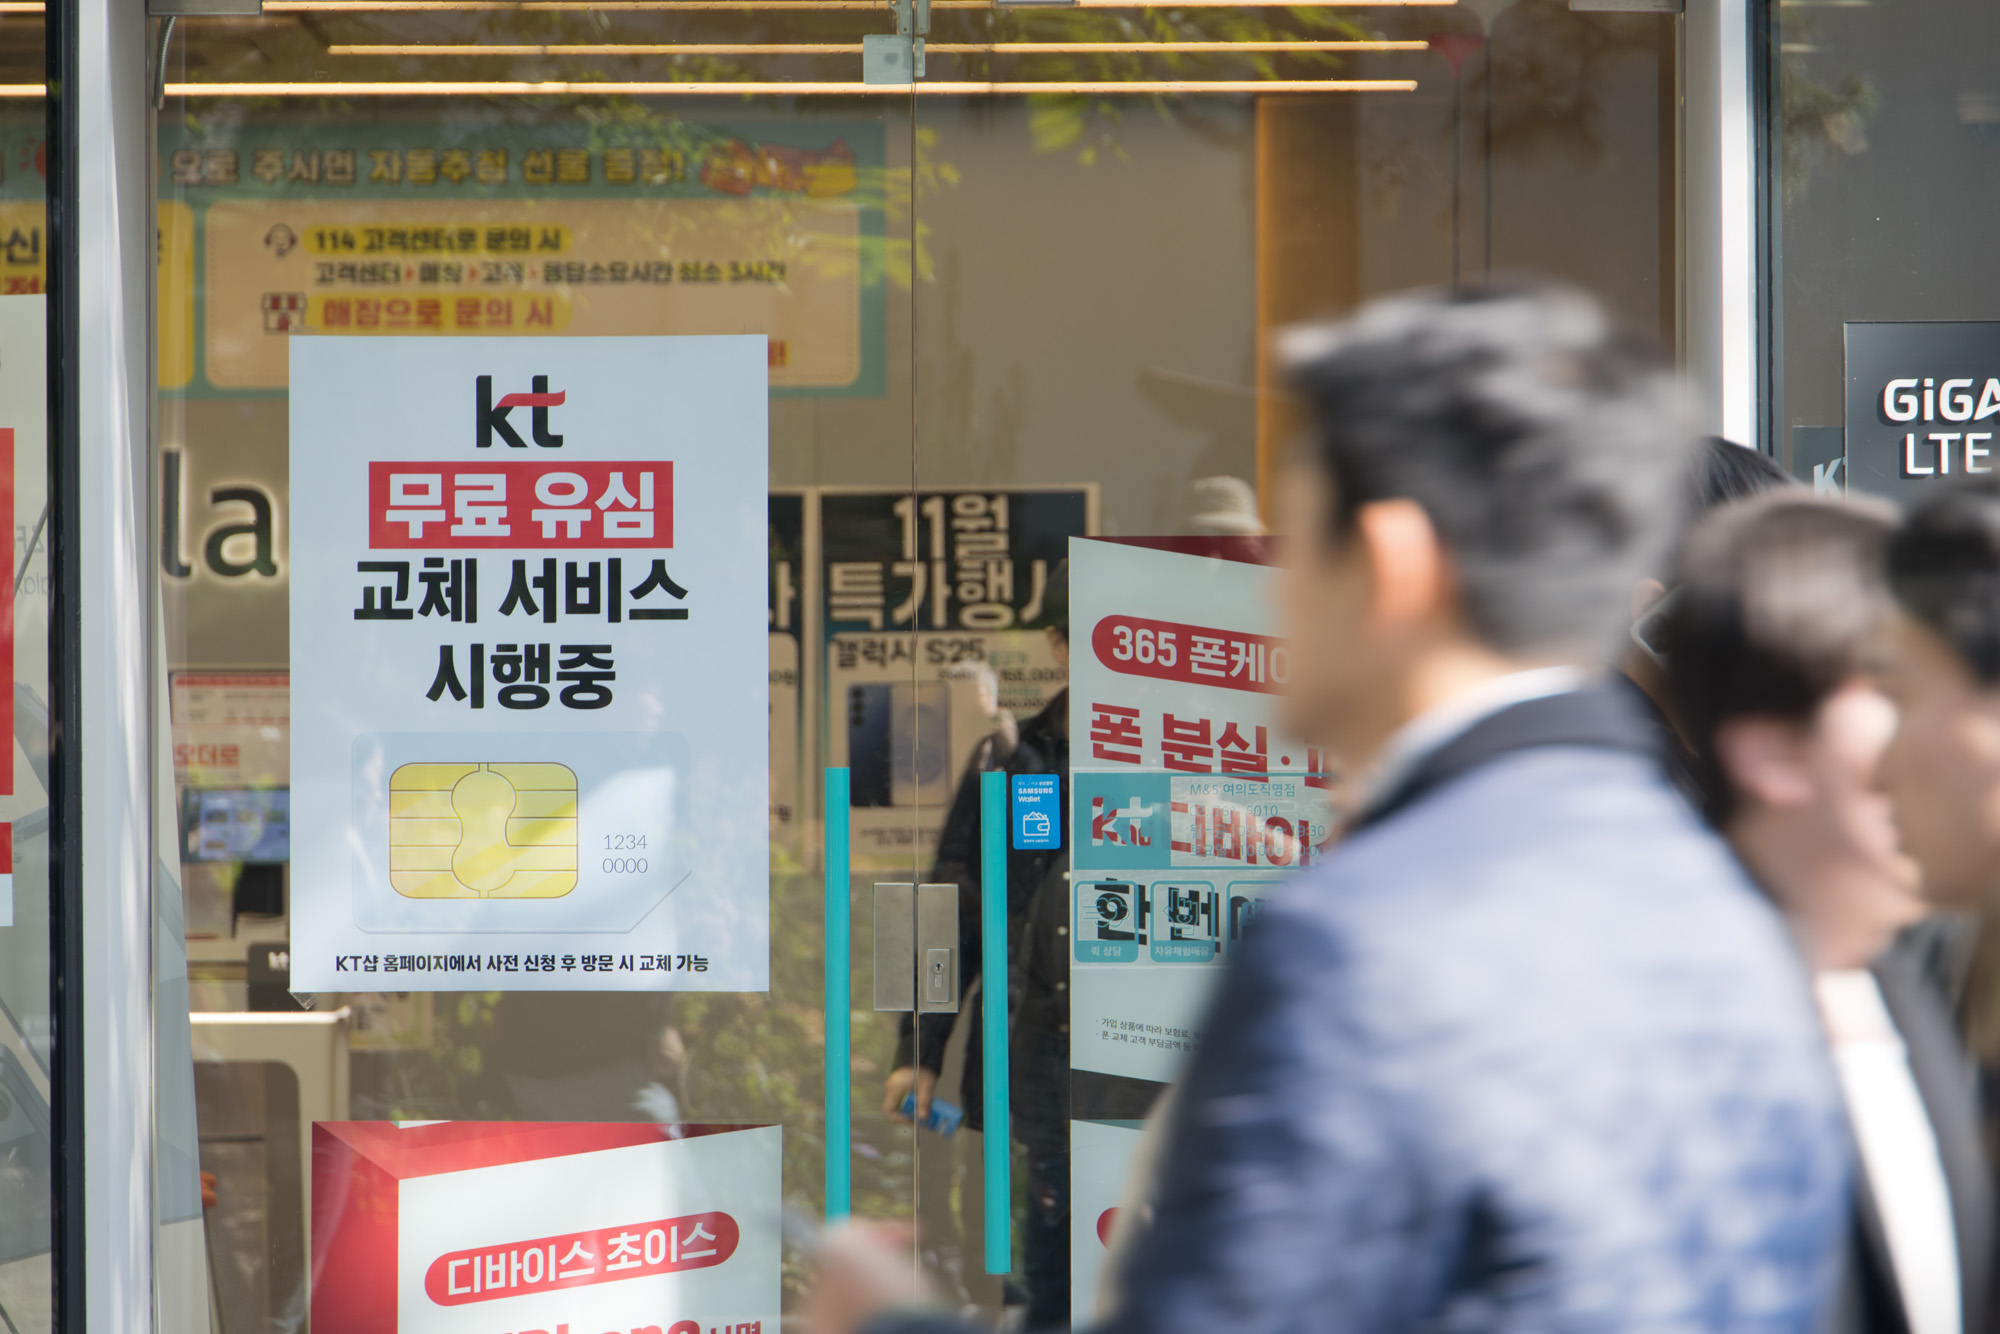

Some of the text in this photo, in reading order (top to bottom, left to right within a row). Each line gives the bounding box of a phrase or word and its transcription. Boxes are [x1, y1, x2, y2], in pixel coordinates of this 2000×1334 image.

[253, 149, 357, 184] 주시면
[315, 228, 356, 251] 114
[538, 228, 561, 252] 시
[324, 297, 553, 328] 매장으로 문의 시
[476, 375, 565, 448] kt
[1905, 432, 1992, 475] LTE
[385, 471, 655, 539] 무료 유심
[892, 494, 1009, 560] 11월
[354, 557, 689, 623] 교체 서비스
[833, 637, 987, 669] 갤럭시 S25
[1112, 625, 1177, 667] 365
[426, 643, 617, 710] 시행중
[1090, 703, 1143, 765] 폰
[1189, 783, 1296, 797] M&S 여의도직영점
[1092, 797, 1153, 846] kt
[603, 834, 648, 851] 1234
[602, 857, 648, 874] 0000
[336, 955, 709, 973] KT샵 홈페이지에서 사전 신청 후 방문 시 교체 가능
[1103, 945, 1122, 957] 상담
[1101, 1018, 1118, 1029] 가입
[1120, 1021, 1144, 1033] 상품에
[1146, 1025, 1162, 1035] 따라
[1112, 1032, 1128, 1043] 교체
[1130, 1035, 1147, 1046] 고객
[1149, 1037, 1181, 1050] 부담금액
[448, 1223, 717, 1296] 디바이스 초이스
